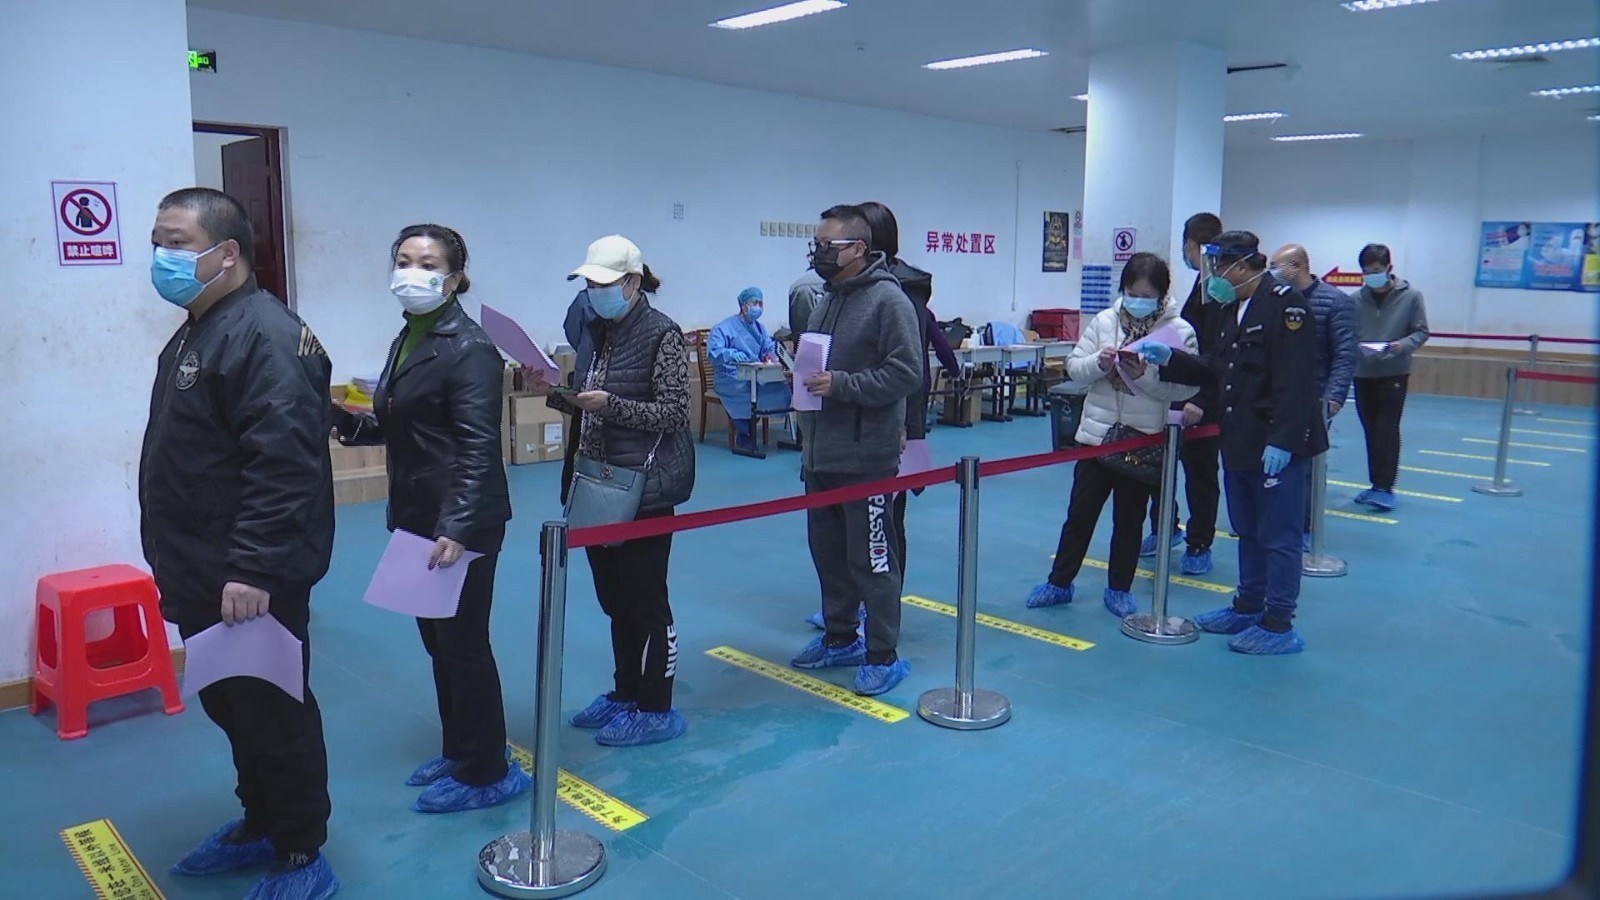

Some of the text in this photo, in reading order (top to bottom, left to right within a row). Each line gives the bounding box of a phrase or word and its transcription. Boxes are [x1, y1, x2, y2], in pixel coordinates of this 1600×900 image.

[67, 244, 115, 257] 禁止喧哗
[926, 231, 996, 254] 异常处置区
[868, 494, 890, 573] PASSION
[664, 625, 678, 678] NIKE
